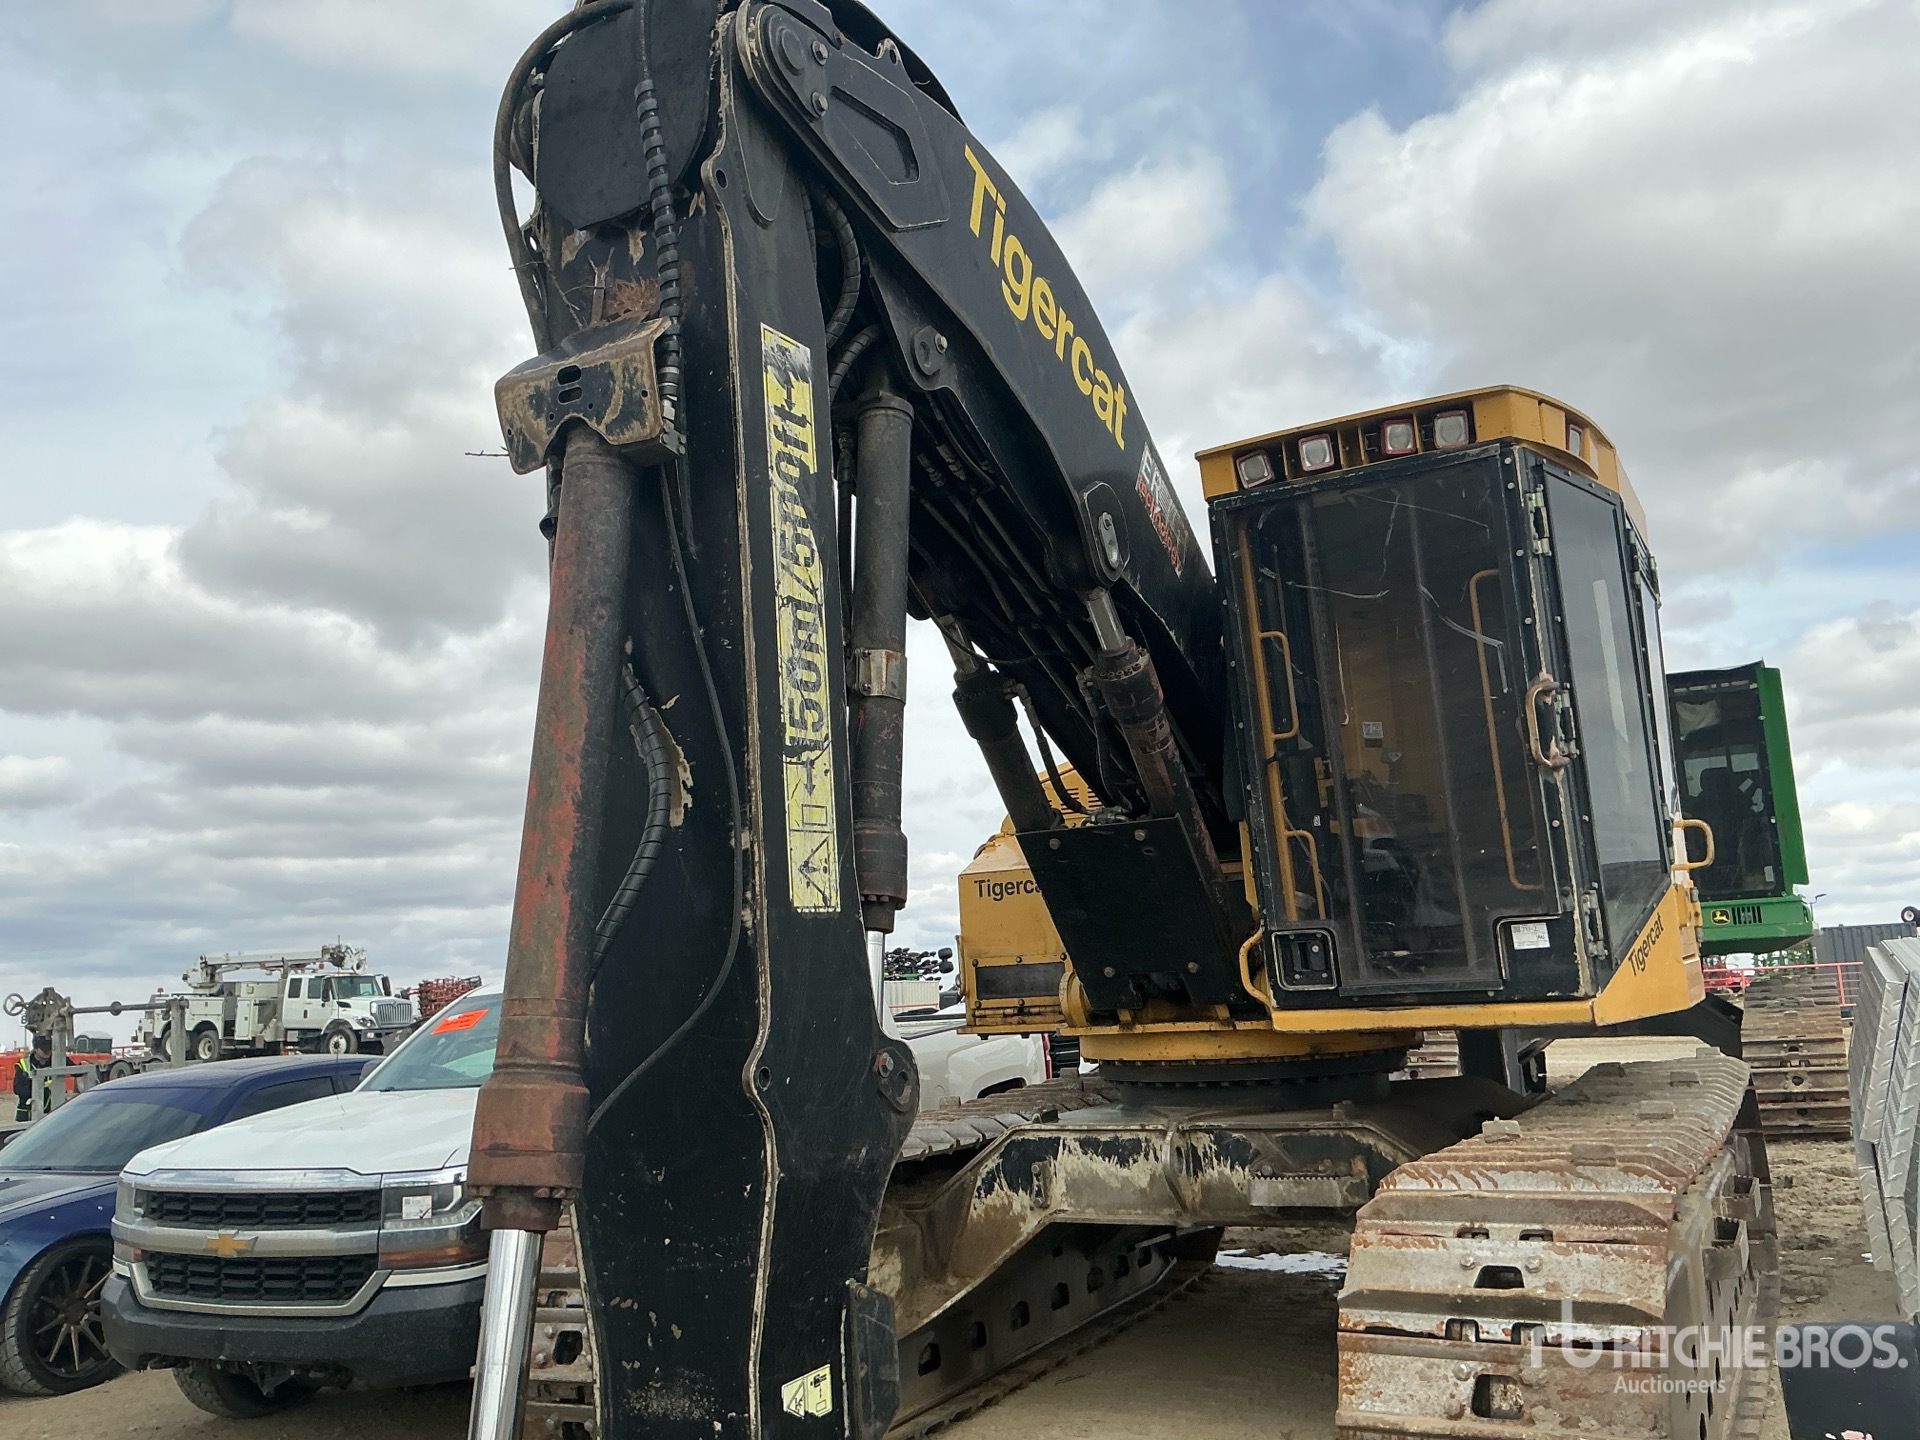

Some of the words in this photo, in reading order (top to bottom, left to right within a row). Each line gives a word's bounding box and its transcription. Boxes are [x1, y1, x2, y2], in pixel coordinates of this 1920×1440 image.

[964, 144, 1127, 450] Tigercat
[974, 879, 1040, 902] Tigerc
[1628, 912, 1664, 976] Tigercat
